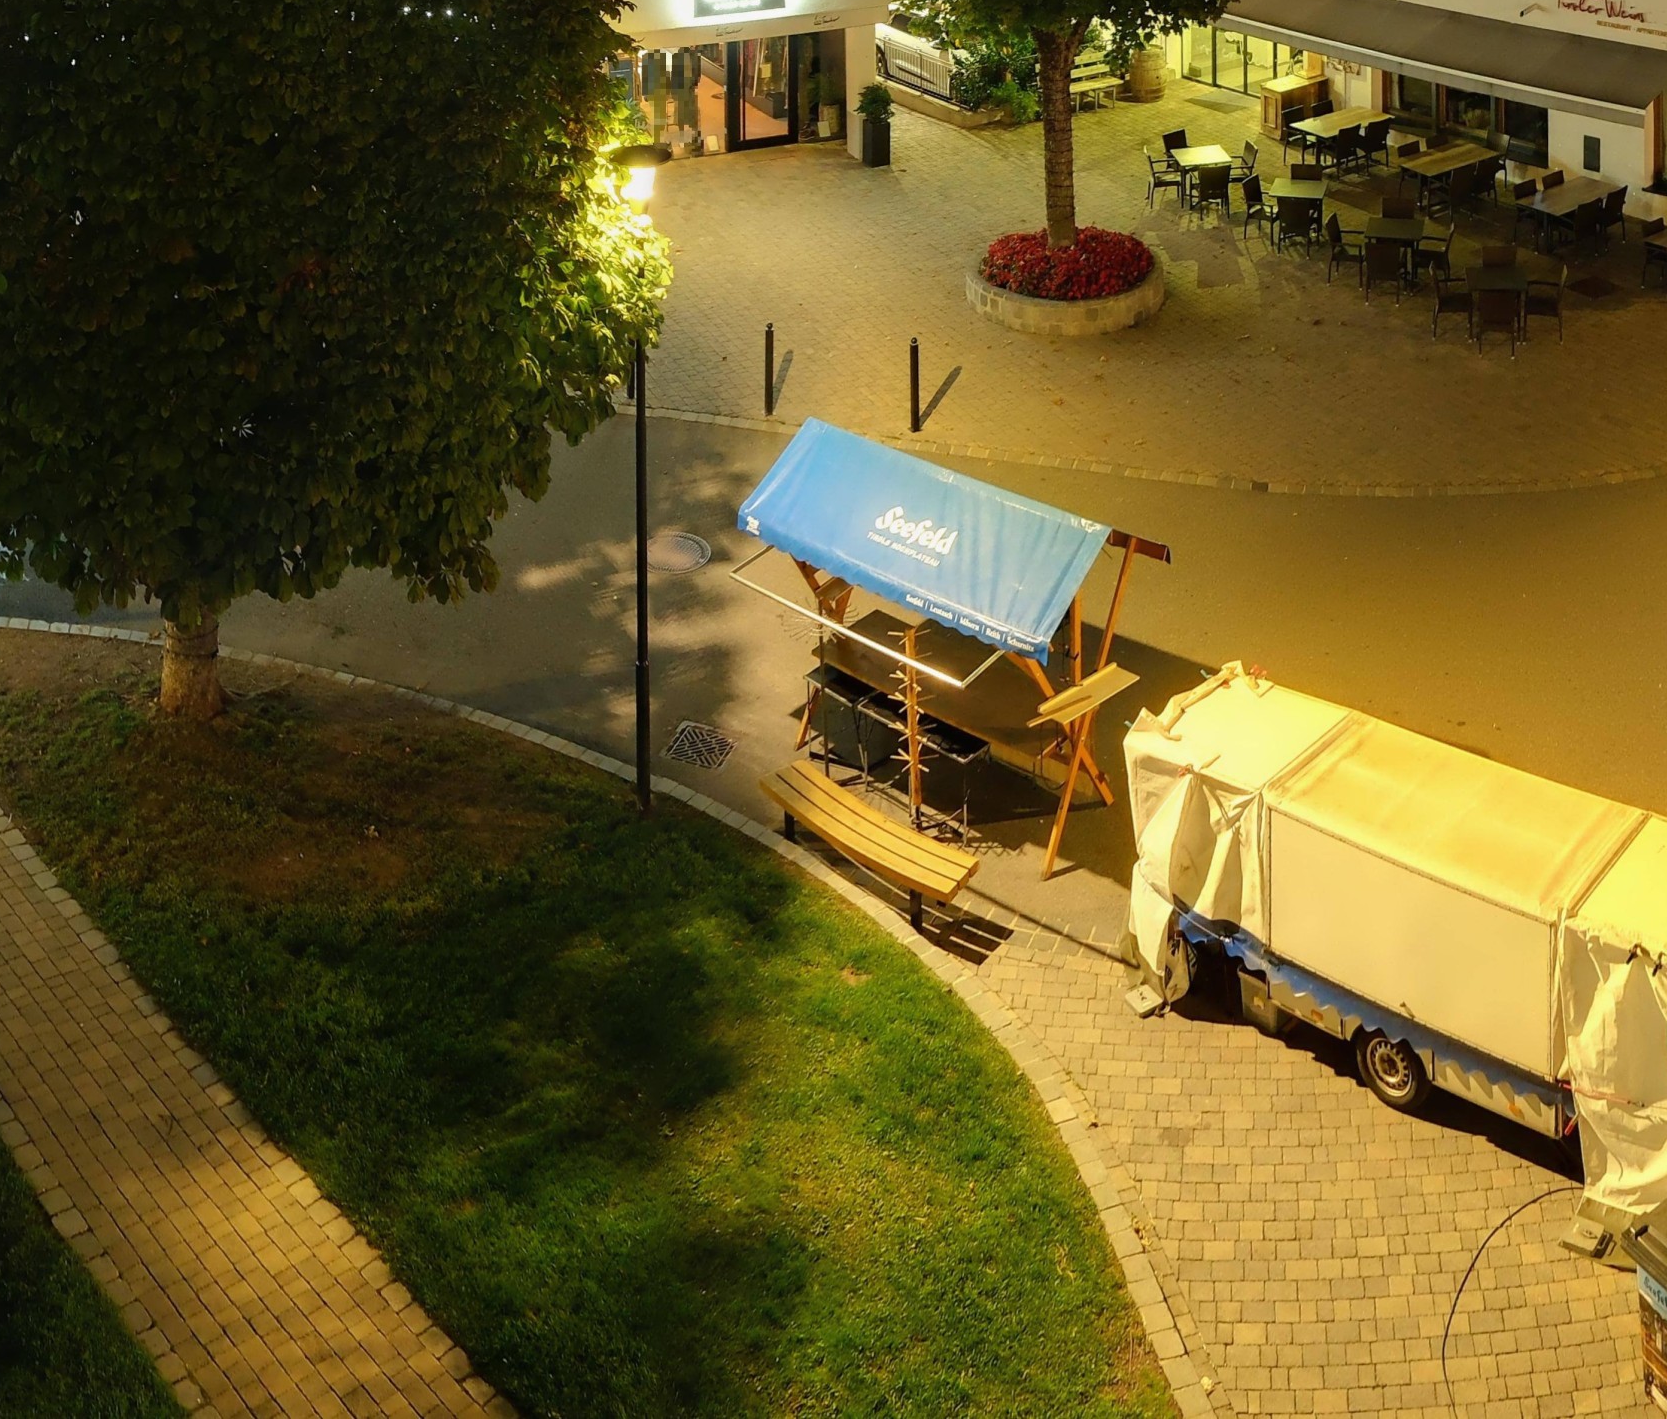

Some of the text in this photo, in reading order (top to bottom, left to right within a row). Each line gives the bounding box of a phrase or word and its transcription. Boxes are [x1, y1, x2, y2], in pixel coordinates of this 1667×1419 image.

[867, 531, 941, 567] TIROLS HOCHPLATEAU
[875, 506, 959, 555] Seefeld
